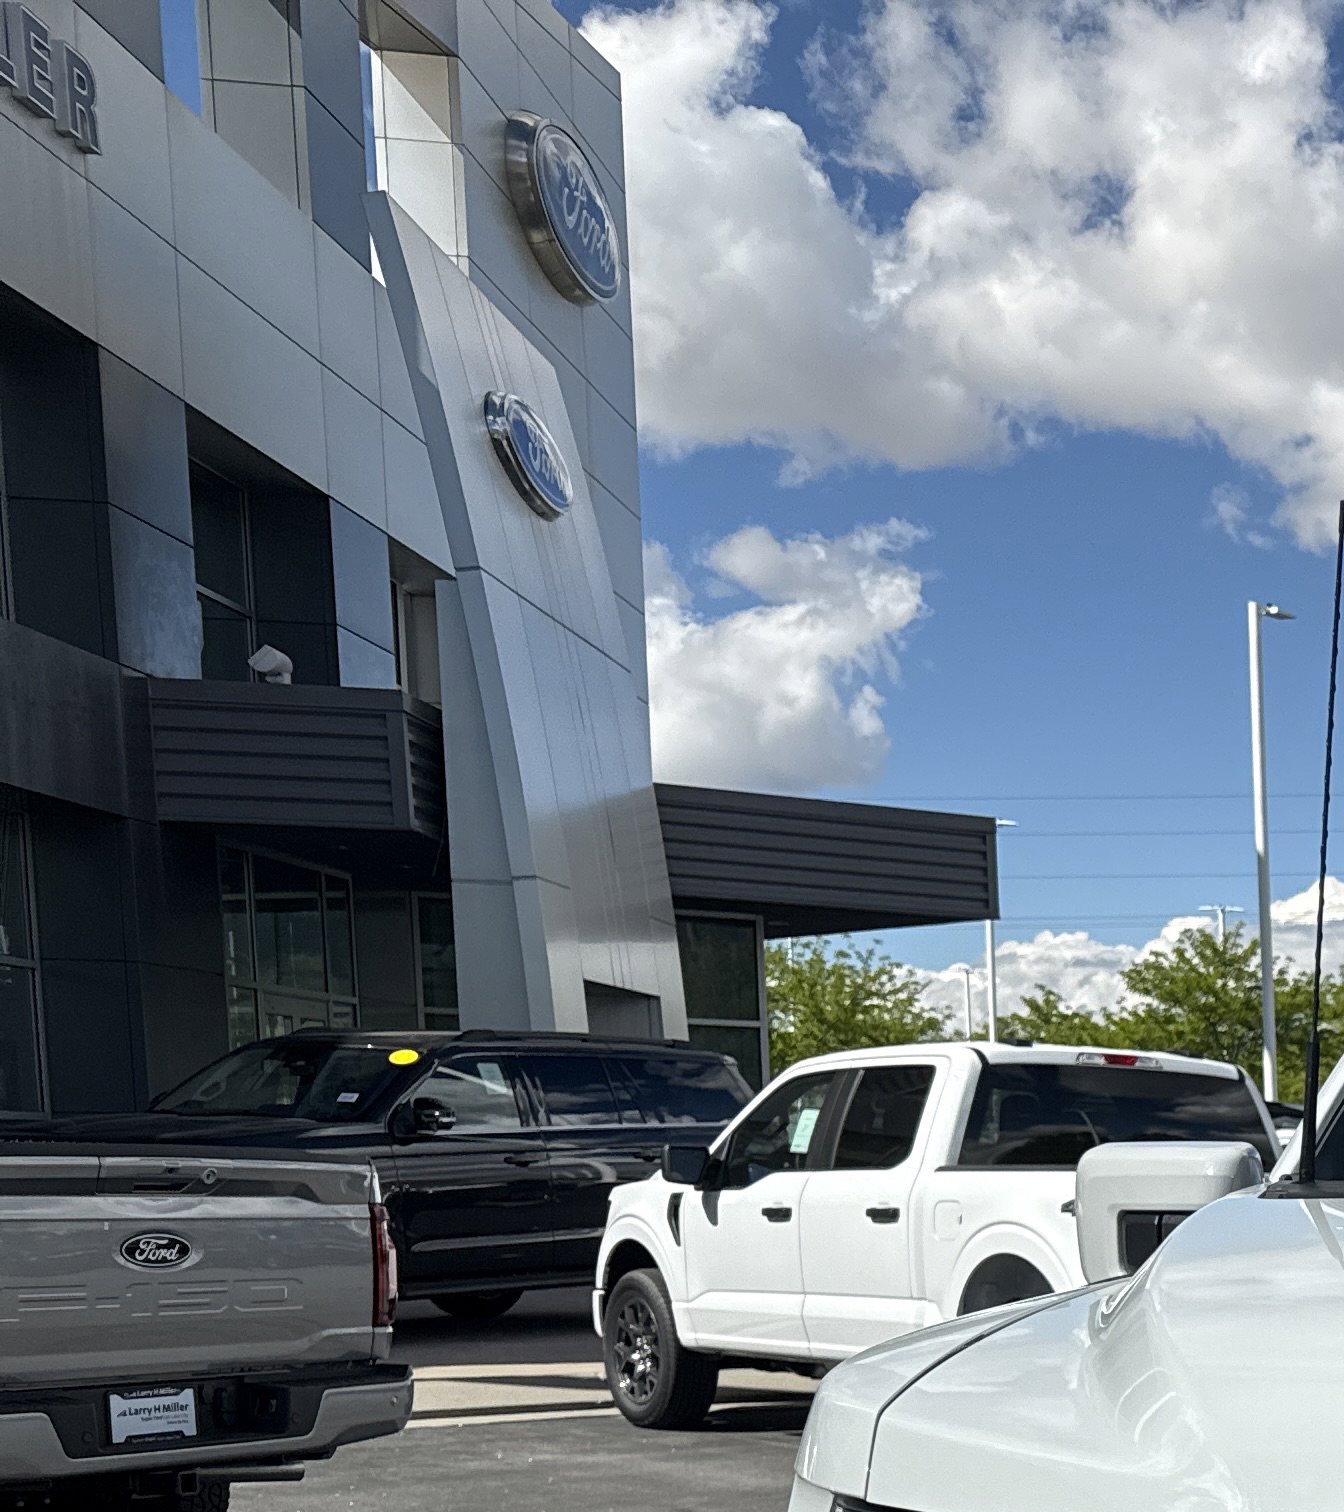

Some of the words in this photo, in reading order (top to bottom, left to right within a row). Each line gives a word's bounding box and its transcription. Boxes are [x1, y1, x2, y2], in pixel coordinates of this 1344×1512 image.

[563, 157, 616, 274] Ford
[135, 1237, 182, 1262] Ford
[128, 1406, 152, 1416] Larry
[154, 1405, 161, 1414] H
[162, 1402, 189, 1413] Miller
